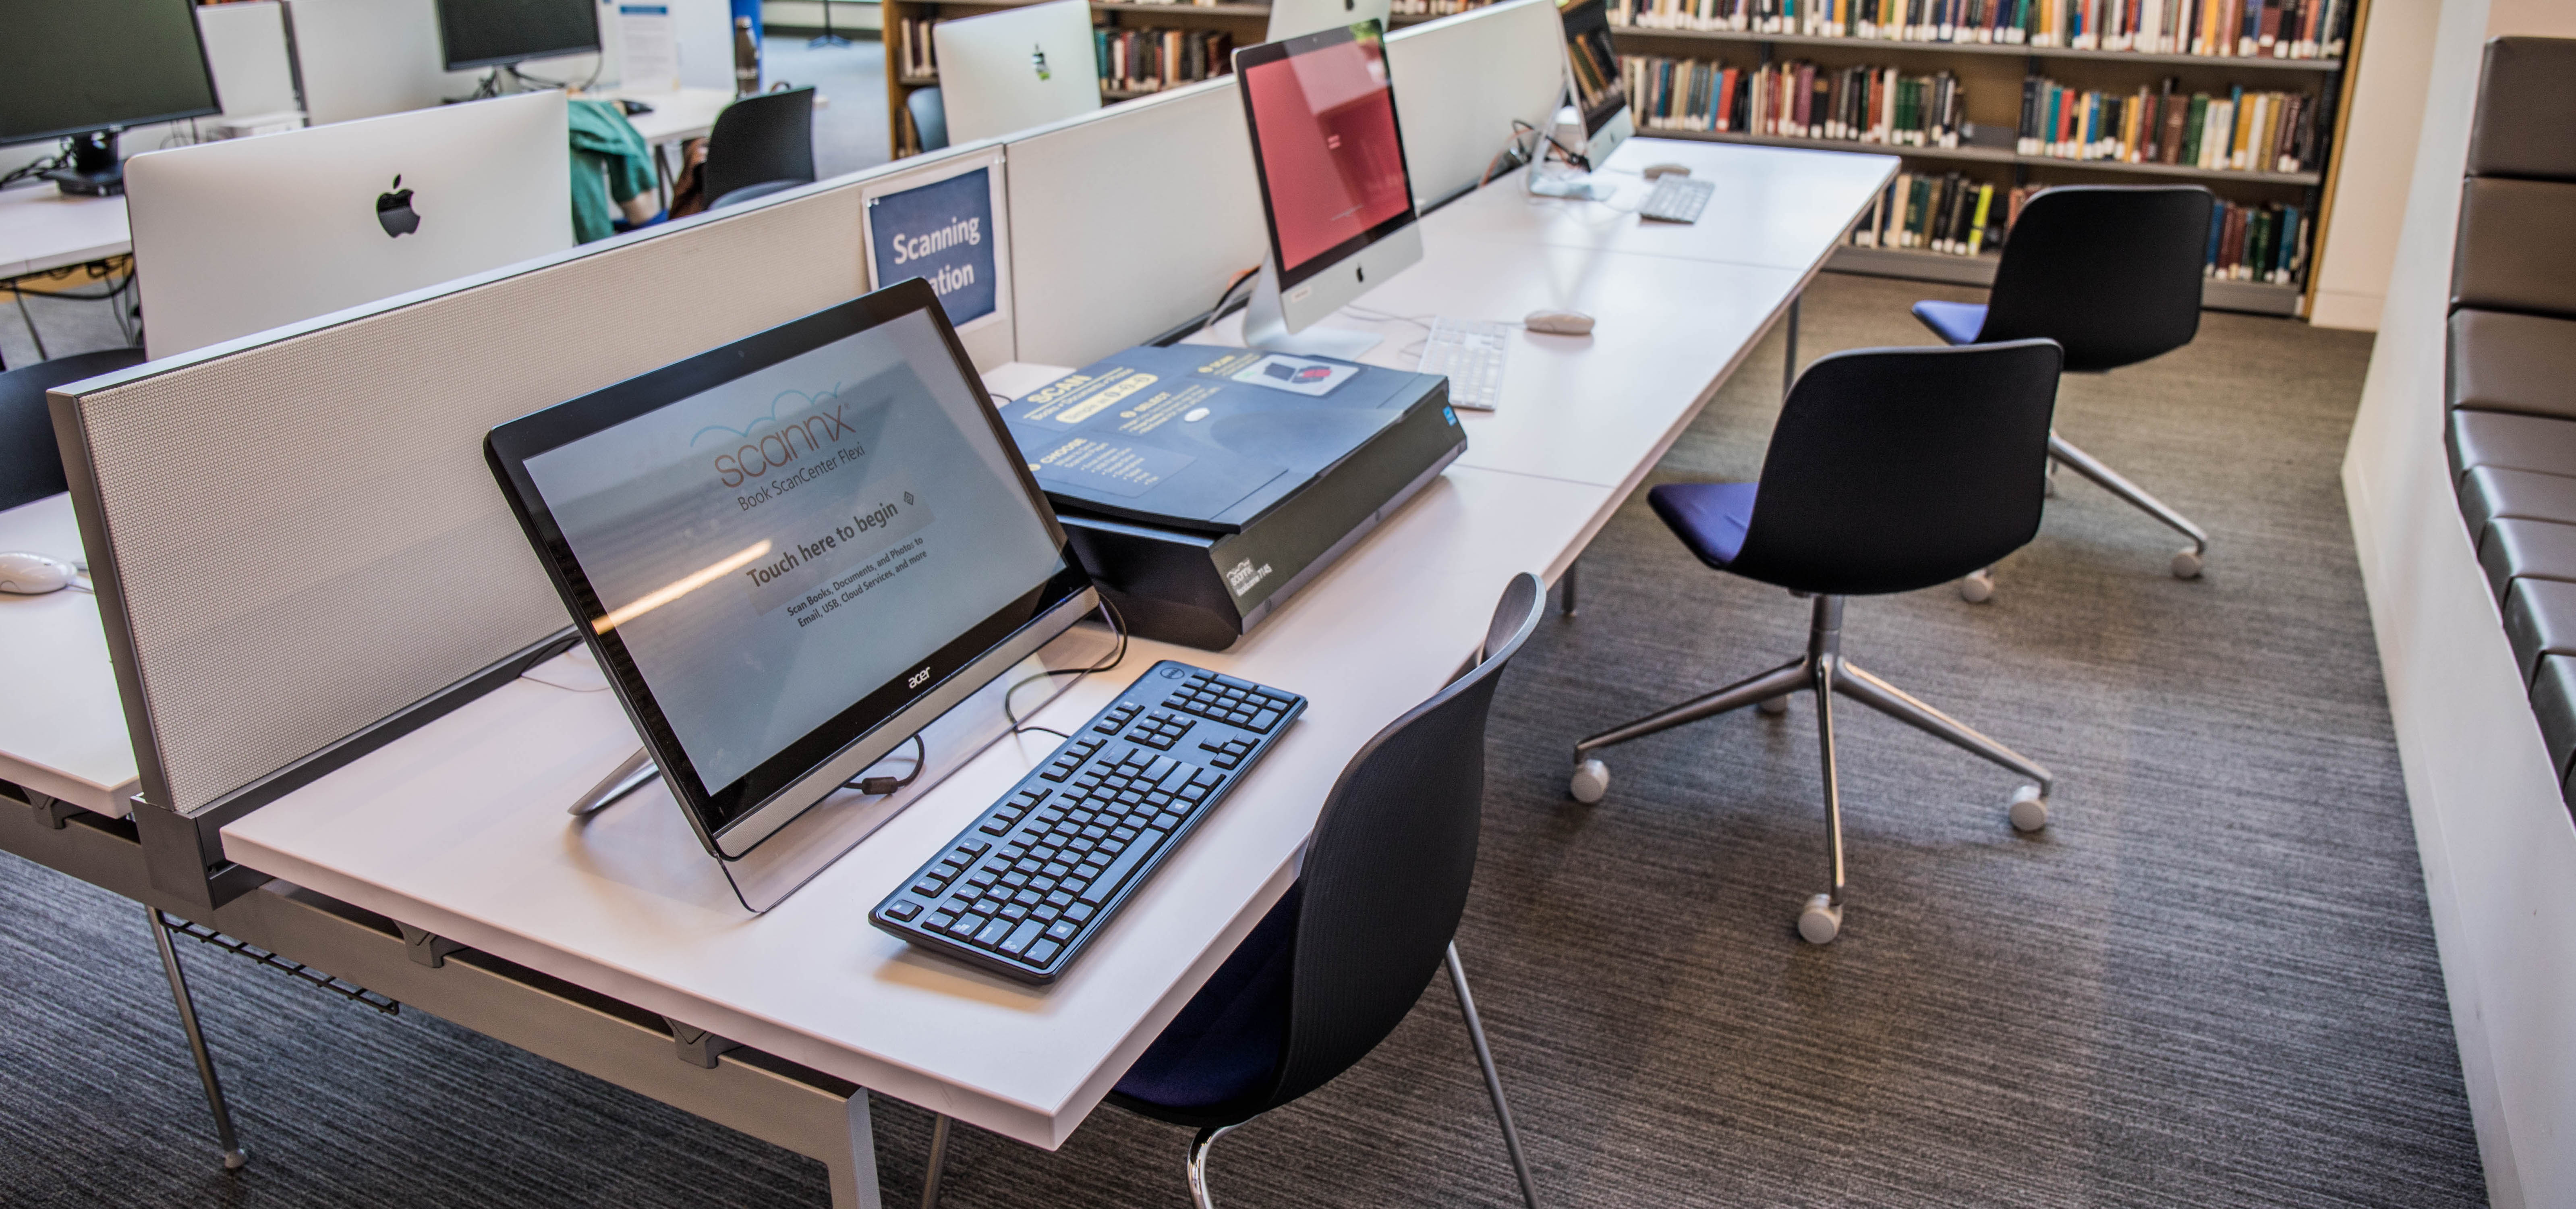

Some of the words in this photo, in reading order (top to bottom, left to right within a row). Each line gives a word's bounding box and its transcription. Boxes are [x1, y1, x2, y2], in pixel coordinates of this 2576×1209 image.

[893, 216, 980, 264] Scanning
[715, 404, 856, 488] scannx
[738, 486, 773, 511] Book
[771, 456, 837, 496] ScanCenter
[837, 442, 865, 465] Flexi
[746, 552, 800, 587] Touch
[797, 535, 836, 562] here
[836, 526, 855, 541] to
[854, 503, 898, 532] begin
[787, 601, 807, 616] Scan
[806, 589, 834, 606] Books,
[833, 564, 877, 591] Documents,
[877, 553, 891, 567] and
[889, 542, 915, 559] Photos
[914, 537, 923, 546] to
[798, 608, 823, 628] Email,
[822, 598, 841, 614] USB,
[841, 584, 864, 603] Cloud
[863, 569, 895, 591] Services,
[895, 558, 908, 573] and
[908, 550, 927, 564] more
[908, 666, 931, 689] acer
